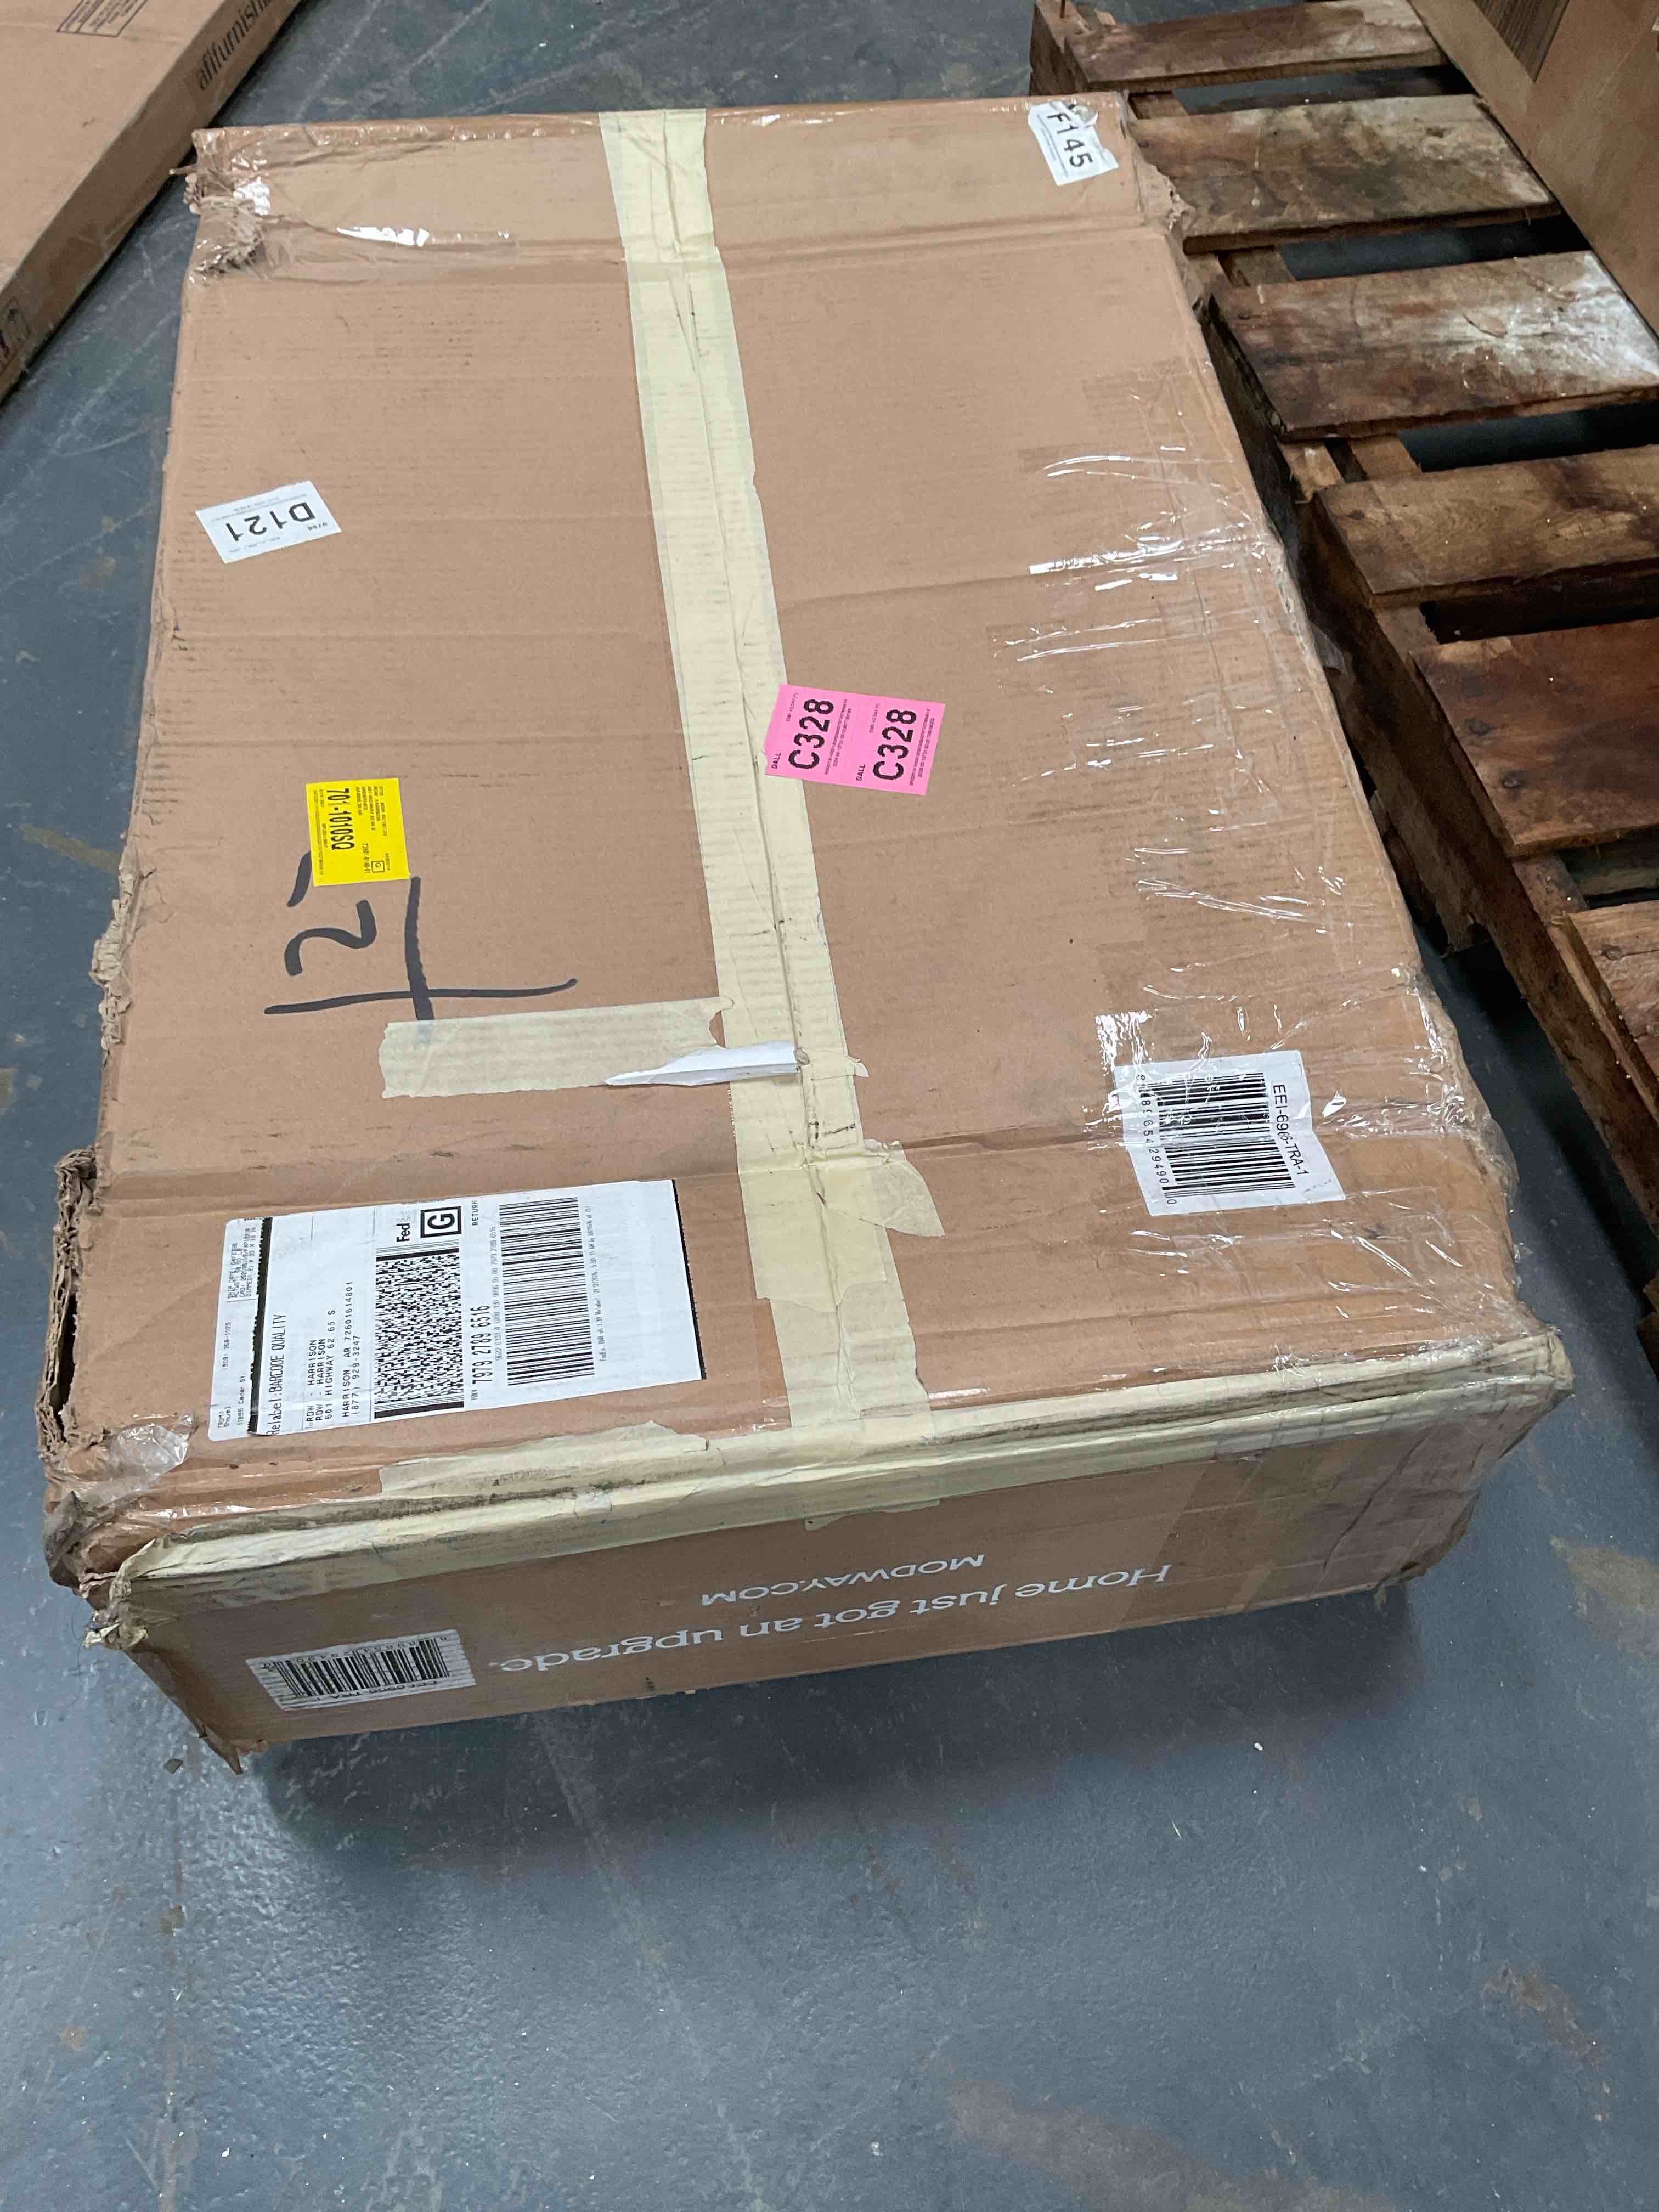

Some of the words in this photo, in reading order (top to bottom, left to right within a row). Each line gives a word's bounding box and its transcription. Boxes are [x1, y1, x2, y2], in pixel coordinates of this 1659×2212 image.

[226, 503, 315, 541] D121
[788, 699, 834, 769] C328
[873, 709, 917, 780] C328
[772, 753, 781, 769] DALL
[856, 764, 866, 781] DALL
[428, 1209, 455, 1231] G
[328, 1321, 335, 1332] 65
[470, 1305, 491, 1328] 6516
[272, 1313, 286, 1351] QUALITY
[327, 1338, 335, 1348] 62
[470, 1333, 492, 1355] 2789
[307, 1340, 317, 1386] HARRISON
[317, 1339, 325, 1385] HARRISON
[343, 1347, 351, 1357] AR
[352, 1335, 360, 1379] 929-3247
[325, 1355, 334, 1396] HIGHWAY
[471, 1361, 493, 1385] 7979
[342, 1369, 351, 1418] HARRISON
[315, 1404, 324, 1421] RDW
[325, 1403, 333, 1419] 601
[702, 1554, 985, 1606] MODWAY.COM
[1015, 1564, 1172, 1598] Home
[910, 1584, 1007, 1615] just
[740, 1618, 803, 1637] an
[814, 1600, 900, 1628] got
